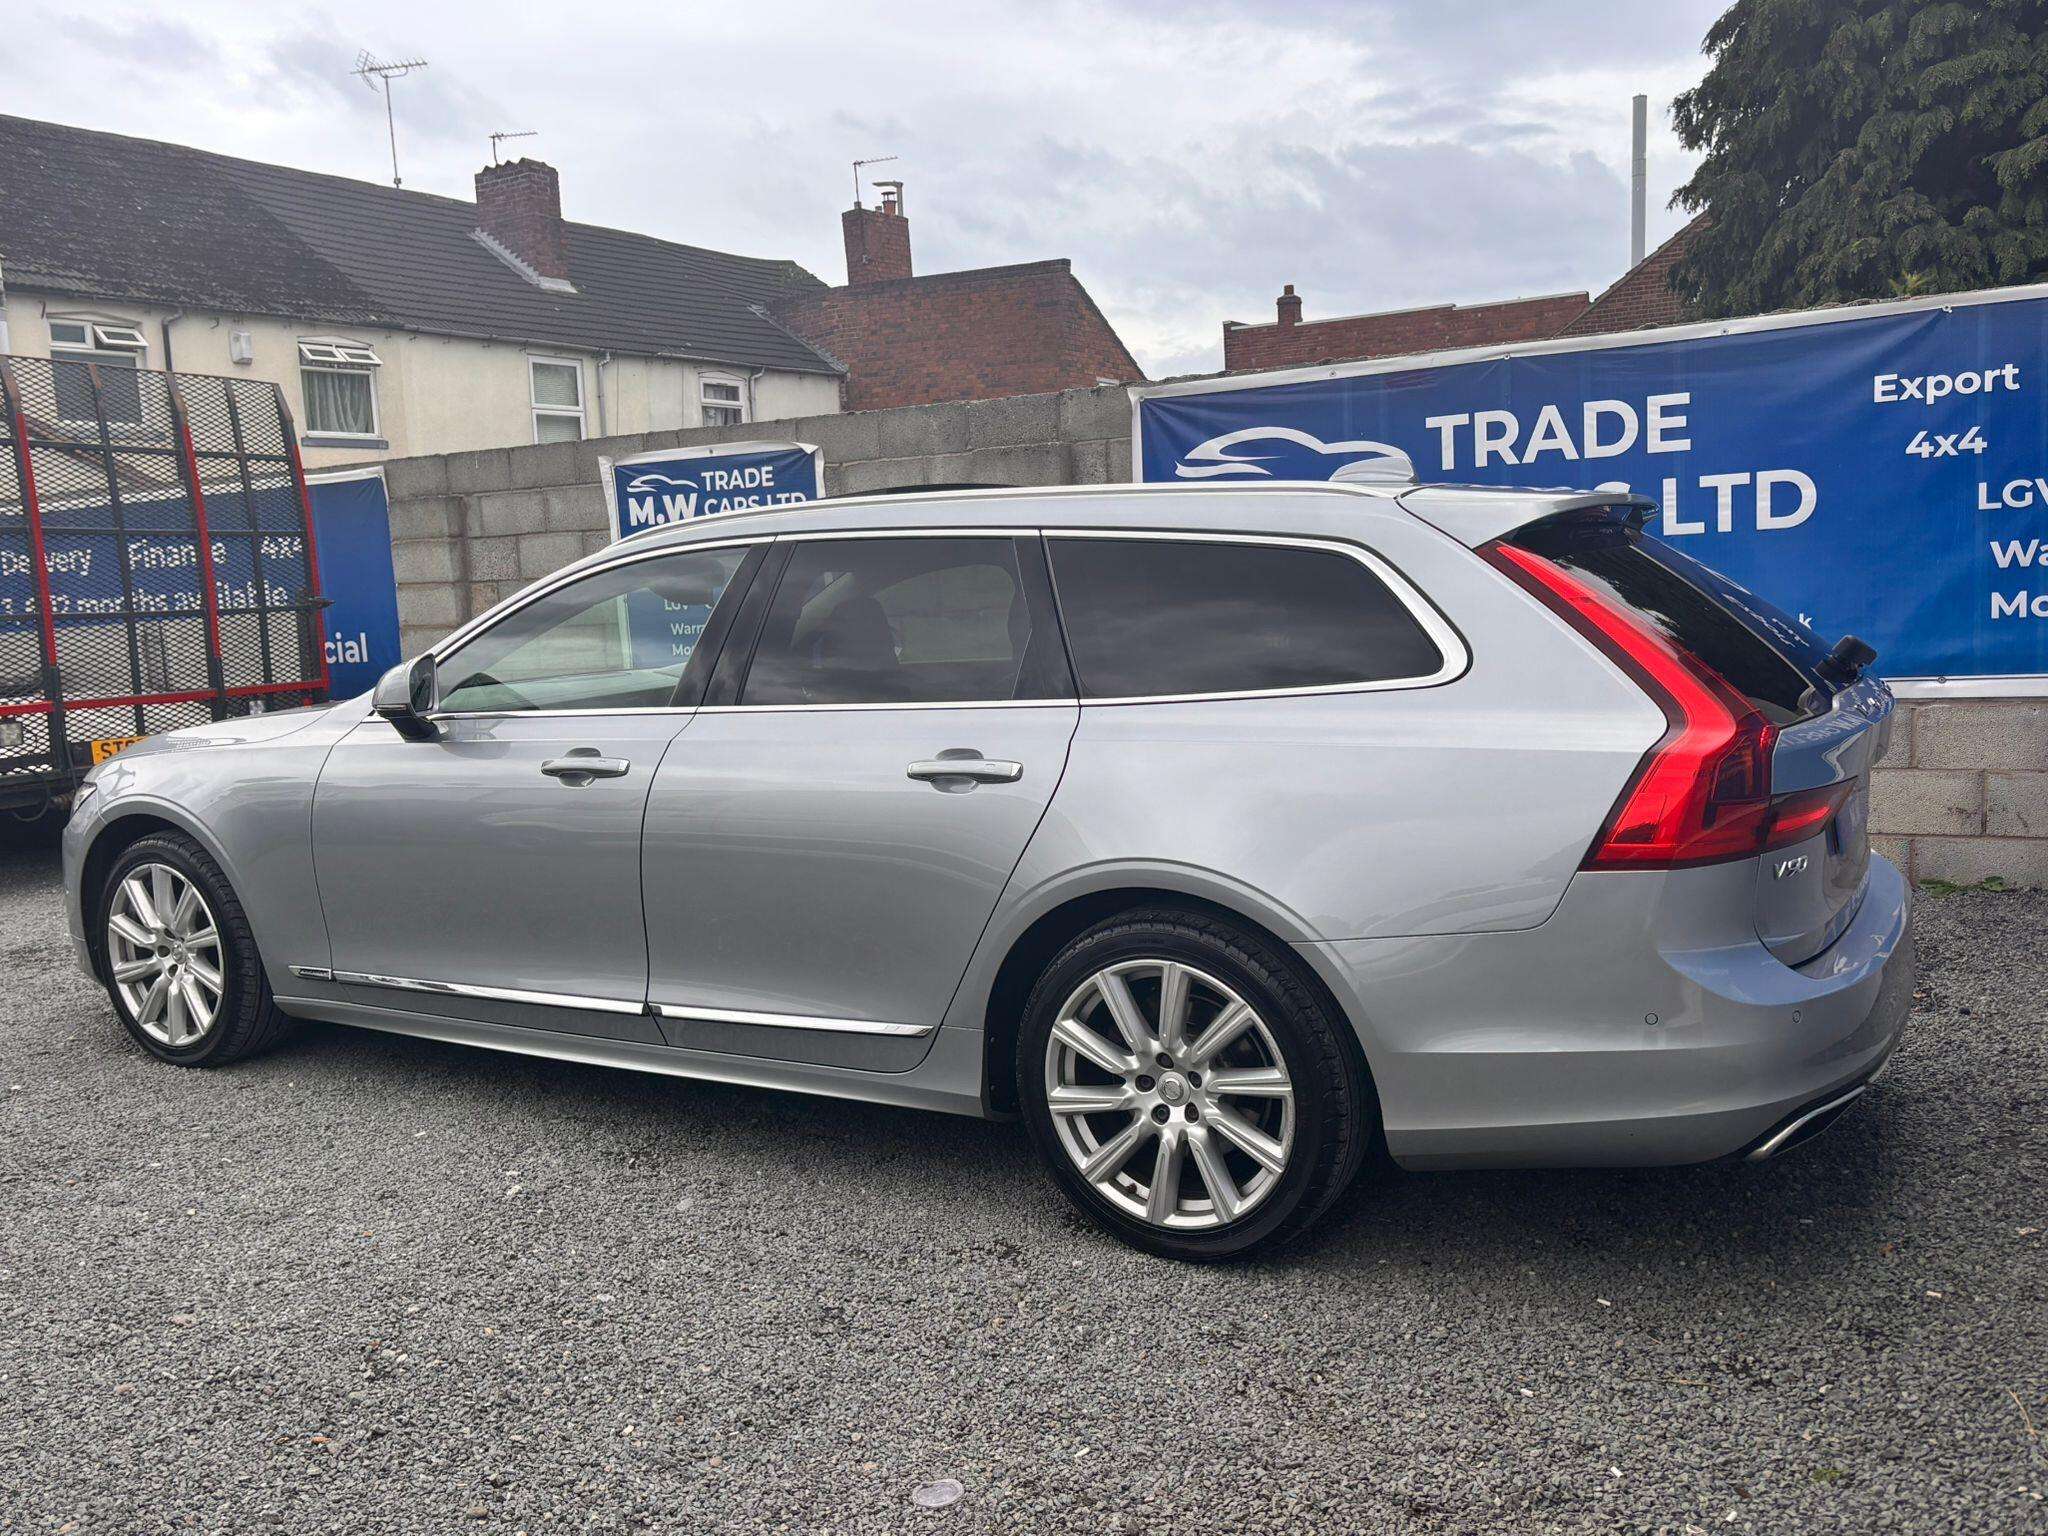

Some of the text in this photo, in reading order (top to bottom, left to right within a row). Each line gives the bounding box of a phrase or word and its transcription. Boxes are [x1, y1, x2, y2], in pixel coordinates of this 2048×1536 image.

[1873, 363, 2020, 405] Export
[1425, 392, 1692, 471] TRADE
[1905, 426, 1988, 459] 4x4
[701, 465, 775, 492] TRADE
[628, 493, 698, 527] M.W
[1662, 469, 1818, 536] LTD
[128, 538, 228, 570] Finane
[174, 579, 288, 611] avilable
